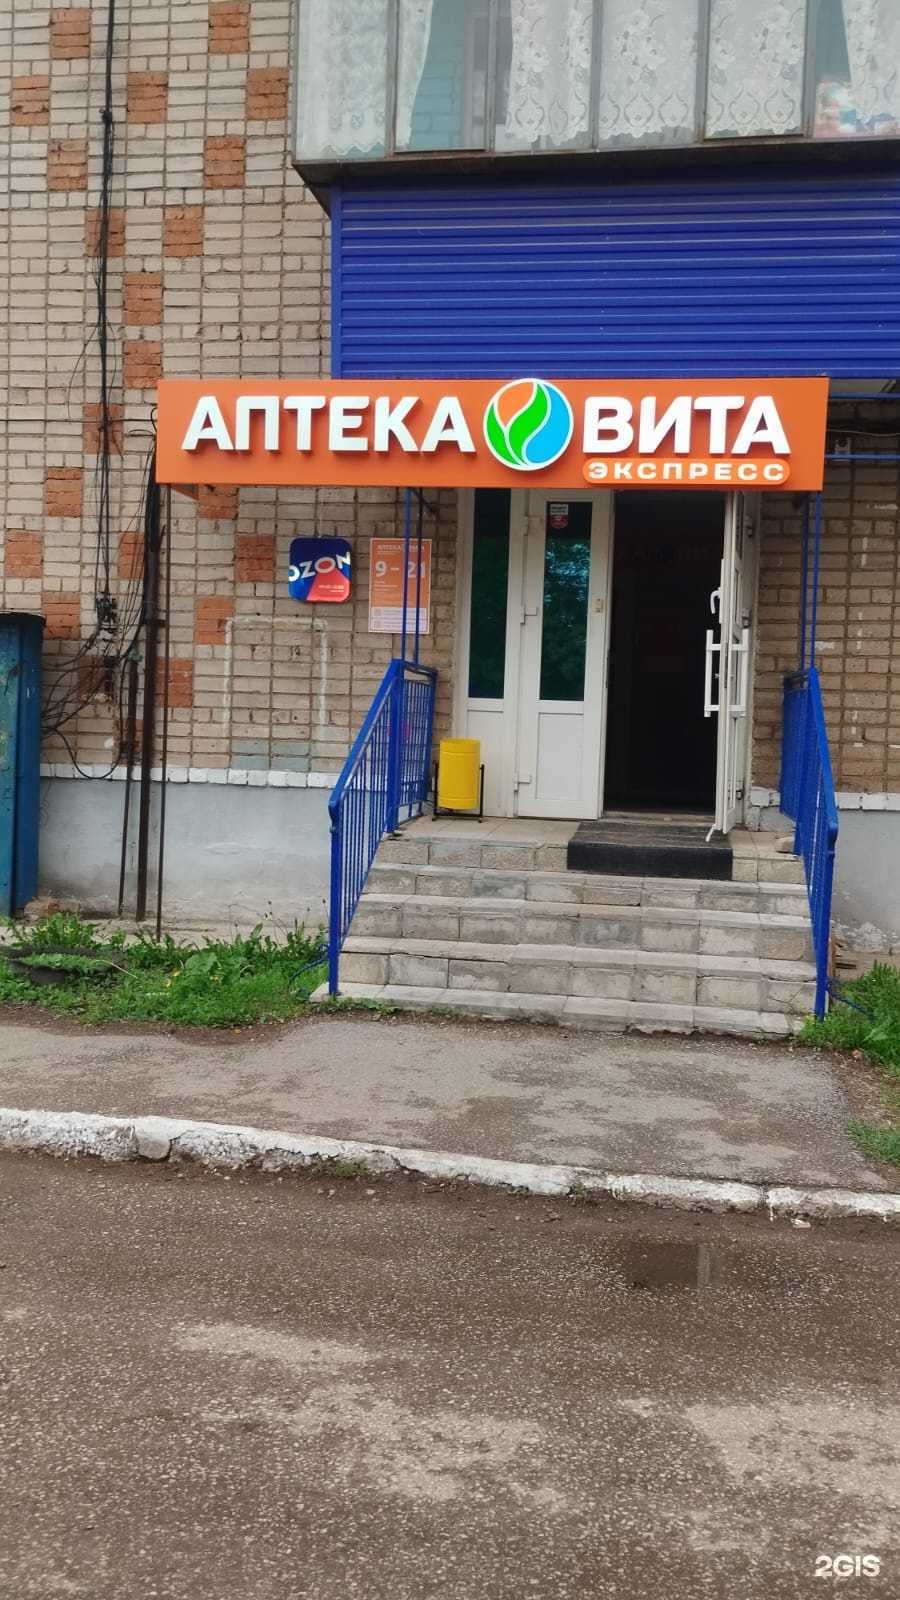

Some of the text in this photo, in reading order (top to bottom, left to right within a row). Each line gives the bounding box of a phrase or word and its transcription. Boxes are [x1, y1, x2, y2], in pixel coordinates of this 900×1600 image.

[181, 395, 791, 454] АПТЕКА ВИТА
[588, 462, 785, 481] ЭКСПРЕСС
[288, 551, 351, 582] OZON
[375, 560, 387, 577] 9
[407, 560, 426, 578] 21
